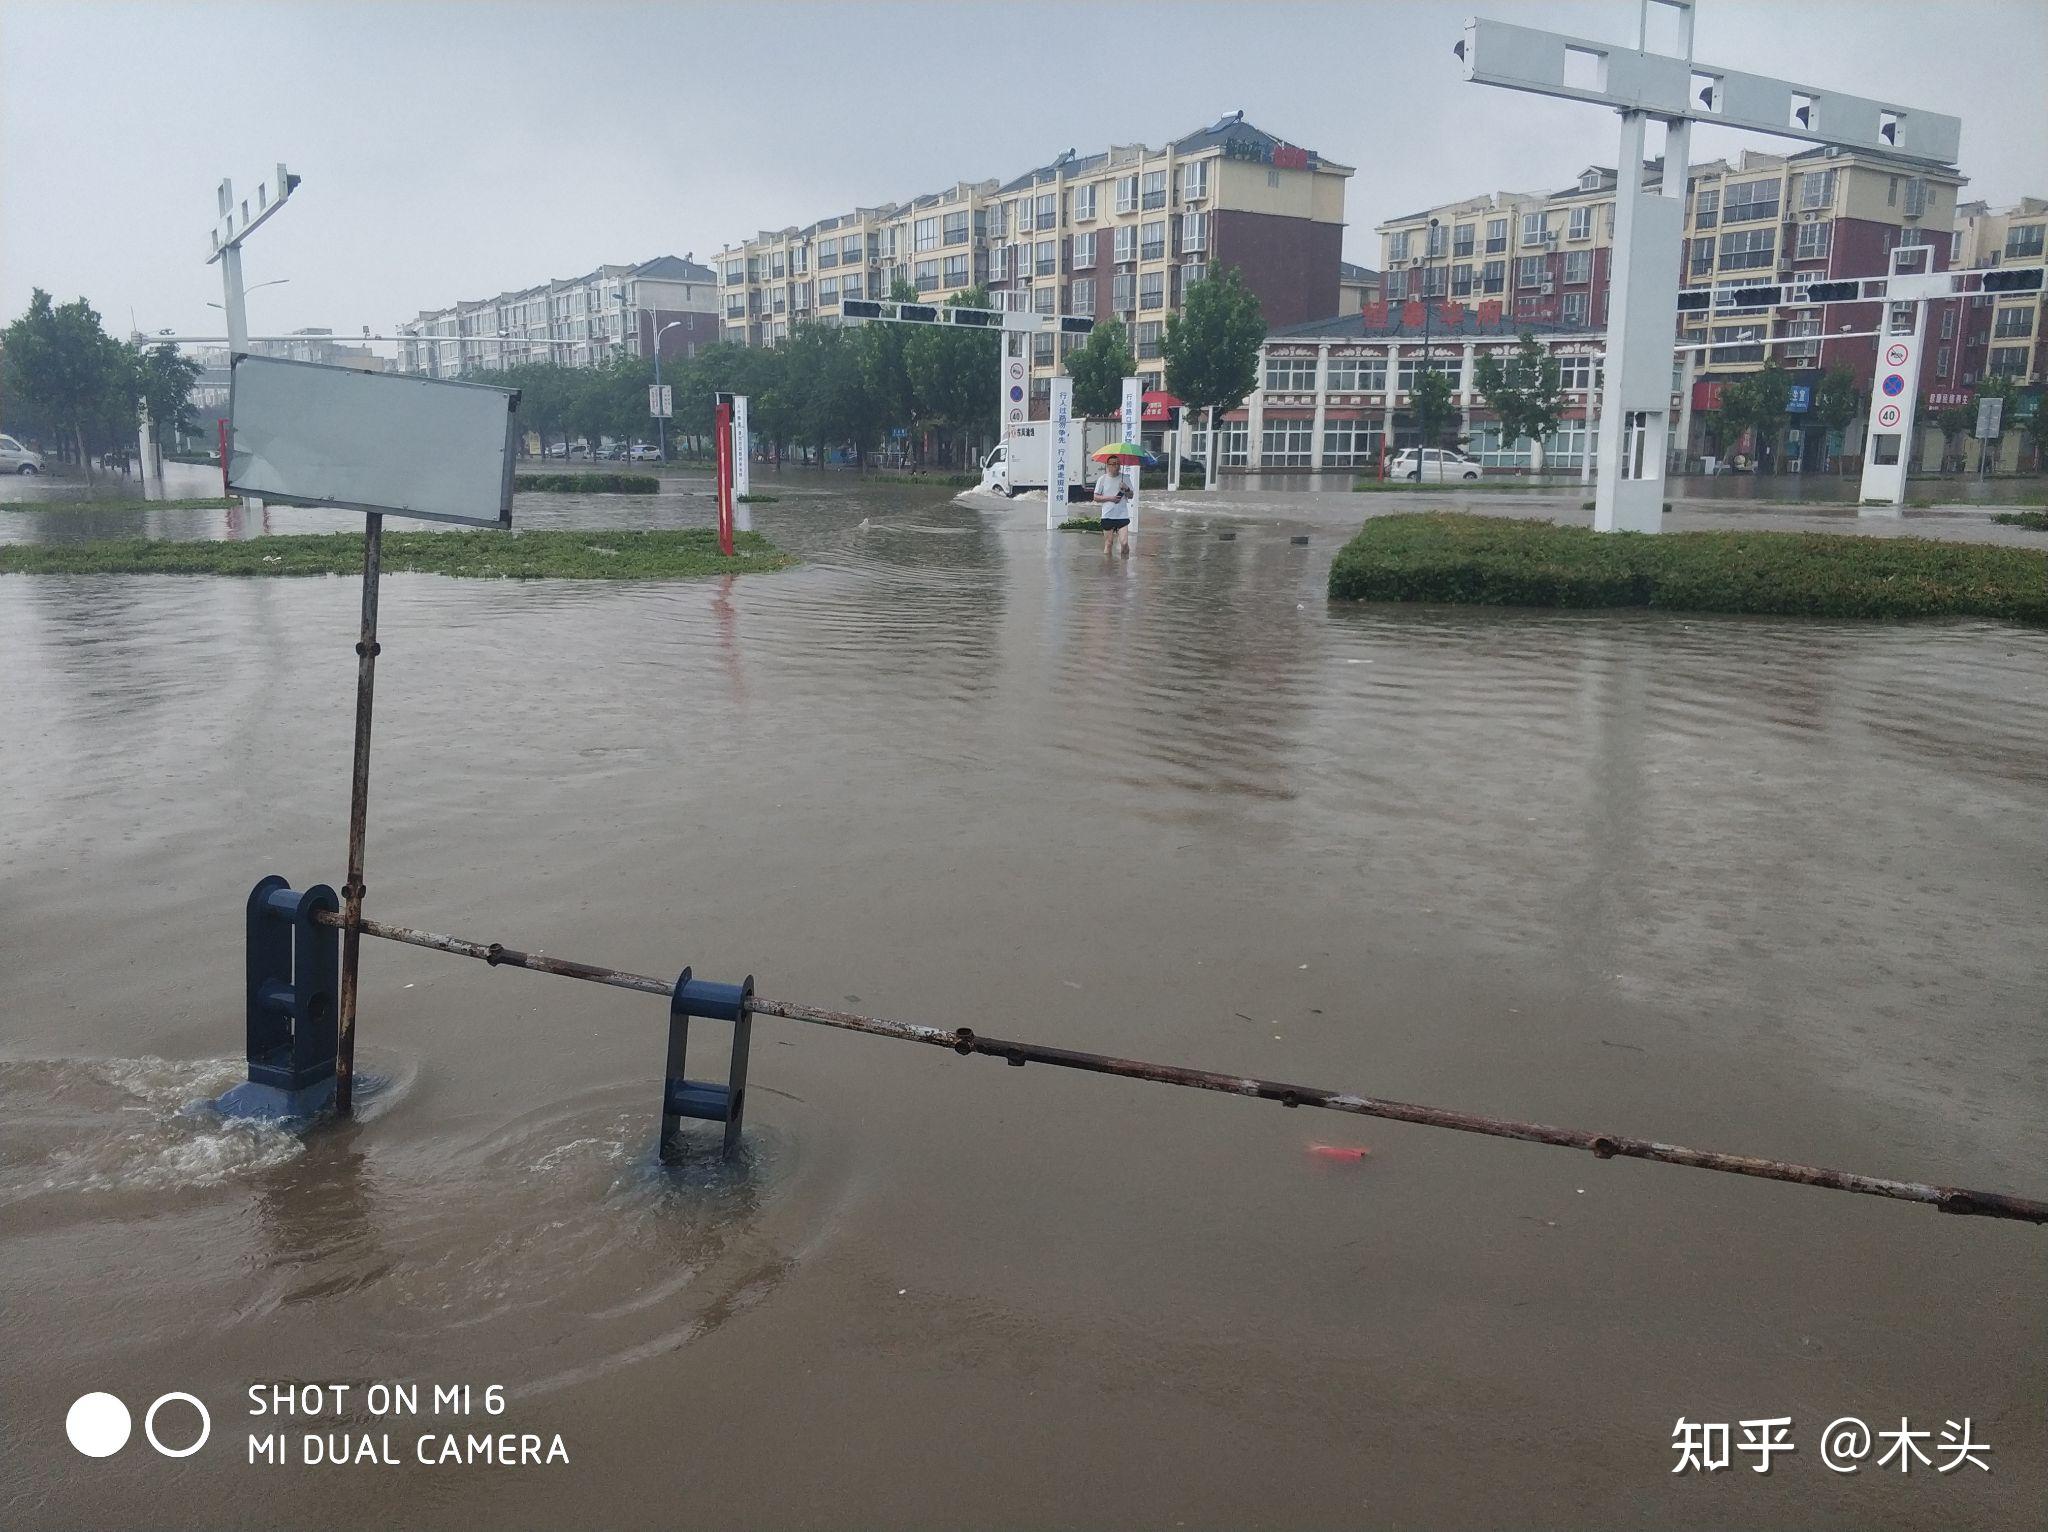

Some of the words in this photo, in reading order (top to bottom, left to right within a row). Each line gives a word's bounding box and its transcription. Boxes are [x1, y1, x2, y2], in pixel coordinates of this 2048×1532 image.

[1012, 412, 1020, 420] 40
[1882, 410, 1896, 421] 40
[1056, 449, 1065, 501] 行人请走斑马线
